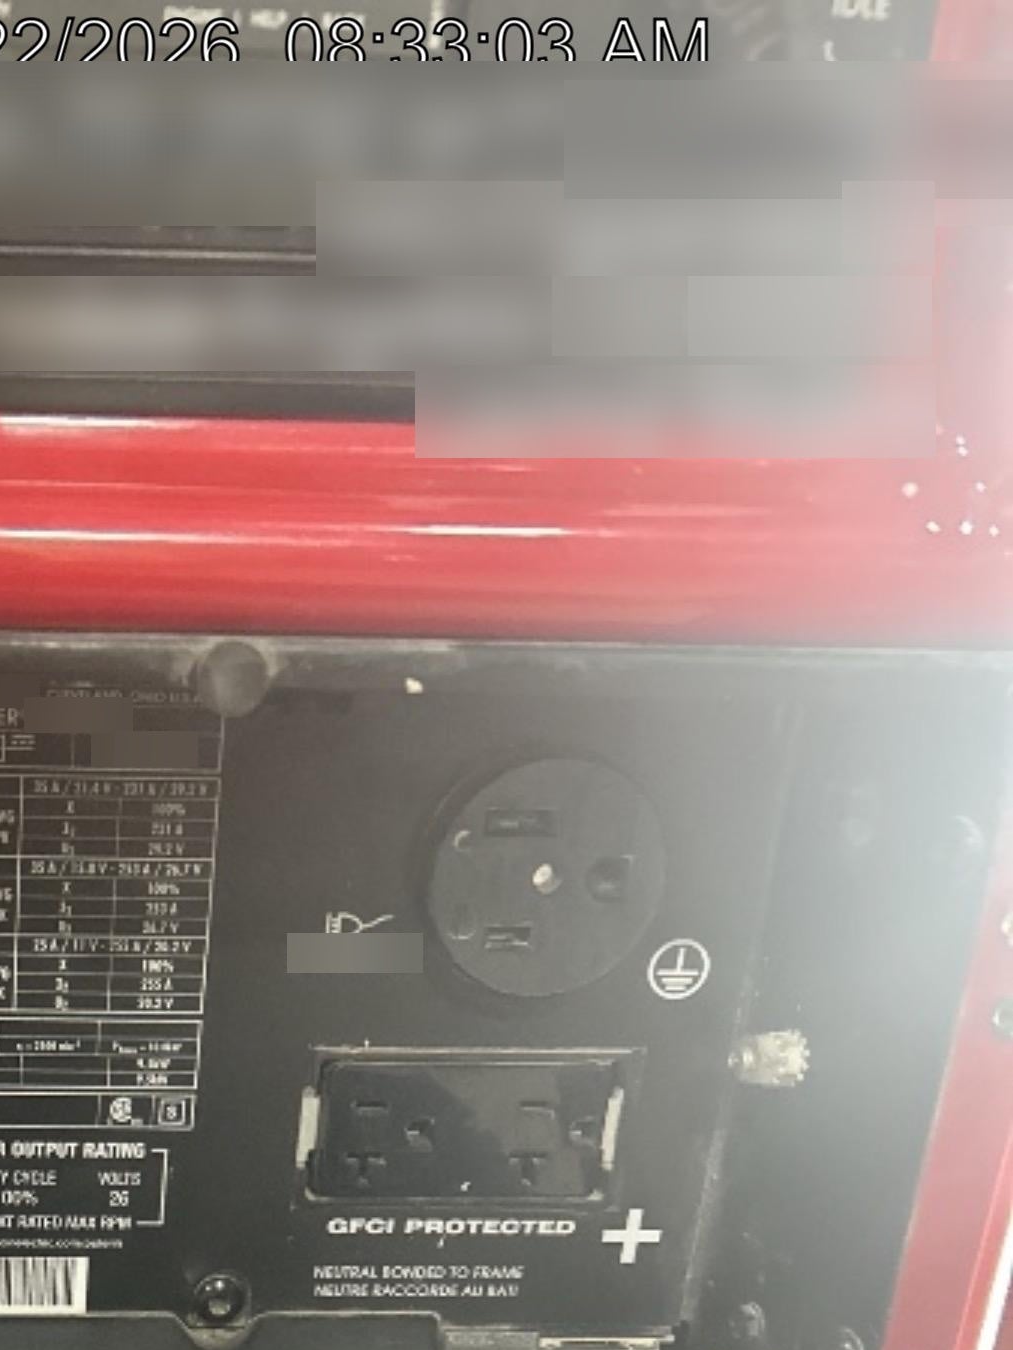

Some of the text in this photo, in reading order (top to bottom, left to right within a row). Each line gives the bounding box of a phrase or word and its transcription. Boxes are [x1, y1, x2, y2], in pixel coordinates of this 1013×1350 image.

[10, 1141, 78, 1159] OUTPUT
[82, 1142, 146, 1159] RATING
[13, 1169, 57, 1186] CYCLE
[97, 1171, 141, 1186] VOLTS
[17, 1214, 63, 1229] RATED
[100, 1214, 132, 1230] RPM
[327, 1217, 577, 1235] GFCI PROTECTED
[313, 1265, 524, 1279] NEUTRAL BONDED TO FRAME
[314, 1283, 369, 1297] NEUTRE
